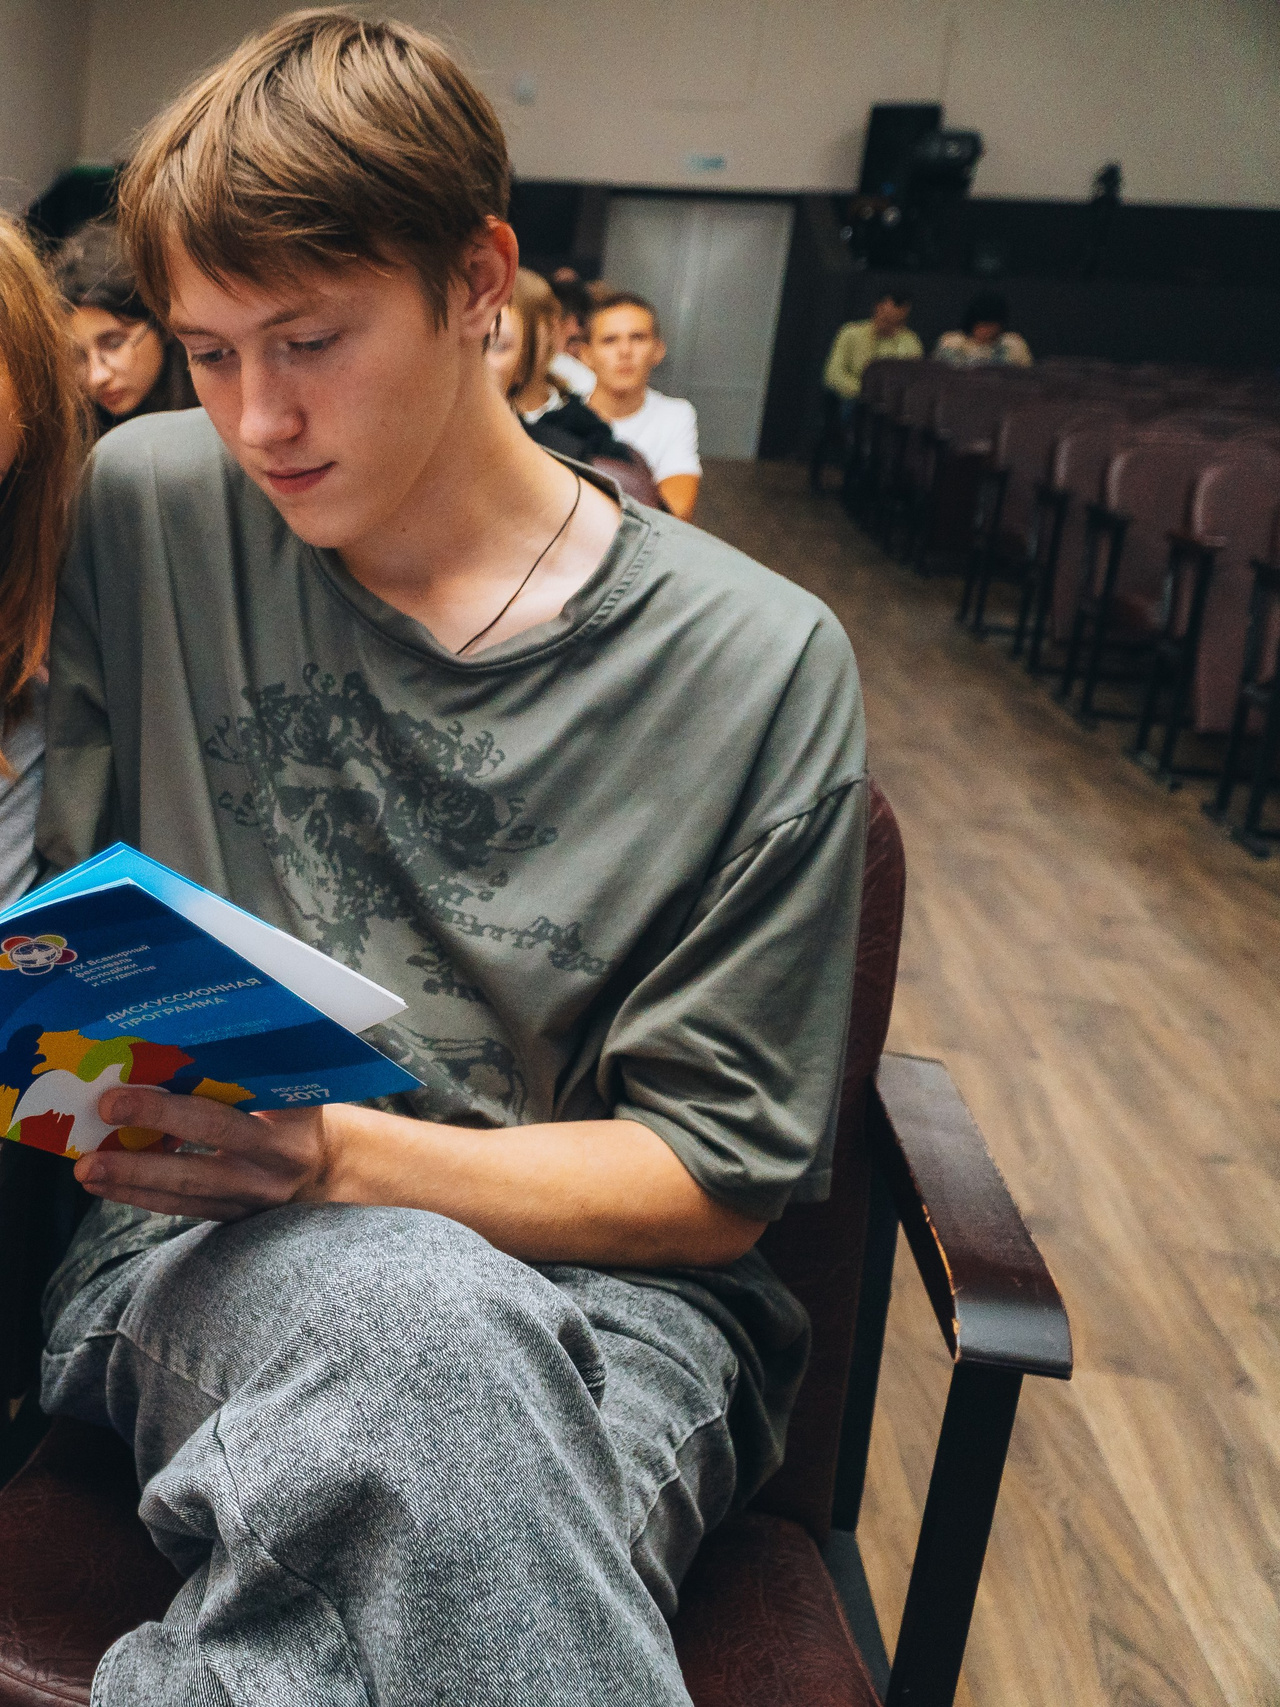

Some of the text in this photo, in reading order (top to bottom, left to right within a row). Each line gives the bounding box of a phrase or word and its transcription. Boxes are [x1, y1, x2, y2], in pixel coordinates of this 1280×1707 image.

[87, 944, 150, 966] Всемирный
[75, 958, 132, 978] фестиваль
[101, 966, 156, 984] студентов
[105, 977, 262, 1023] ДИСКУССИОННАЯ
[118, 997, 228, 1029] ПРОГРАММА
[271, 1083, 321, 1094] РОССИЯ
[279, 1088, 331, 1102] 2017
